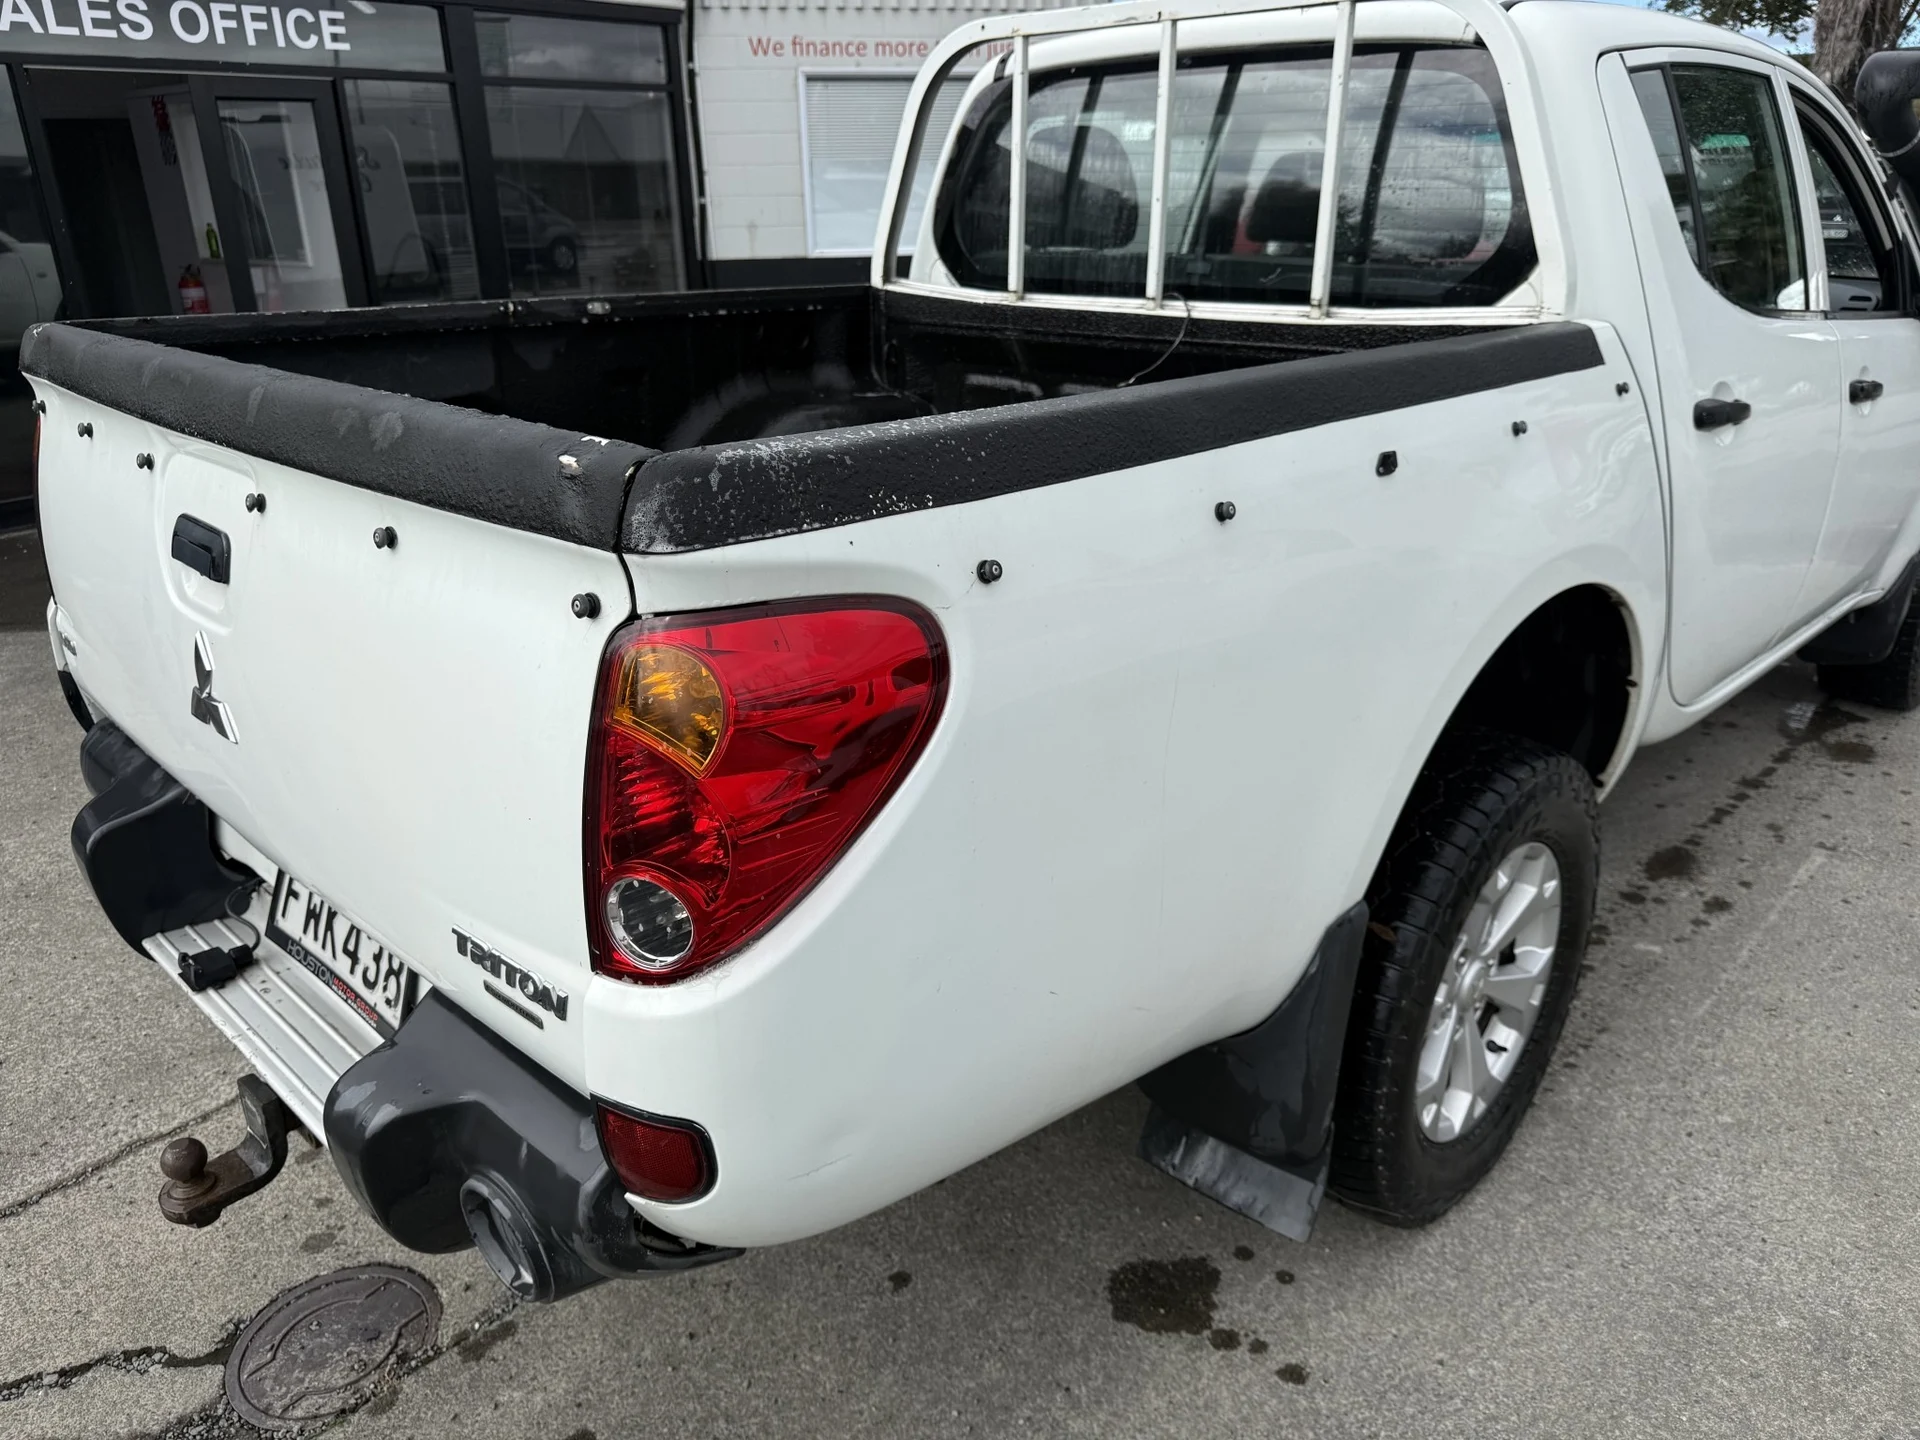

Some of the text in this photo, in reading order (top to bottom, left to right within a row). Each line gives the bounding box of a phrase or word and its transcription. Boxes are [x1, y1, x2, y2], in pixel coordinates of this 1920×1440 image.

[169, 0, 351, 51] OFFICE
[748, 37, 785, 57] We
[791, 35, 868, 57] finance
[874, 39, 929, 57] more
[986, 41, 1014, 61] jus
[281, 876, 406, 1011] FWK438
[286, 939, 335, 986] HOUSTON
[333, 977, 356, 1001] MOTOR
[356, 998, 379, 1021] GROUP
[451, 923, 569, 1021] TRITON
